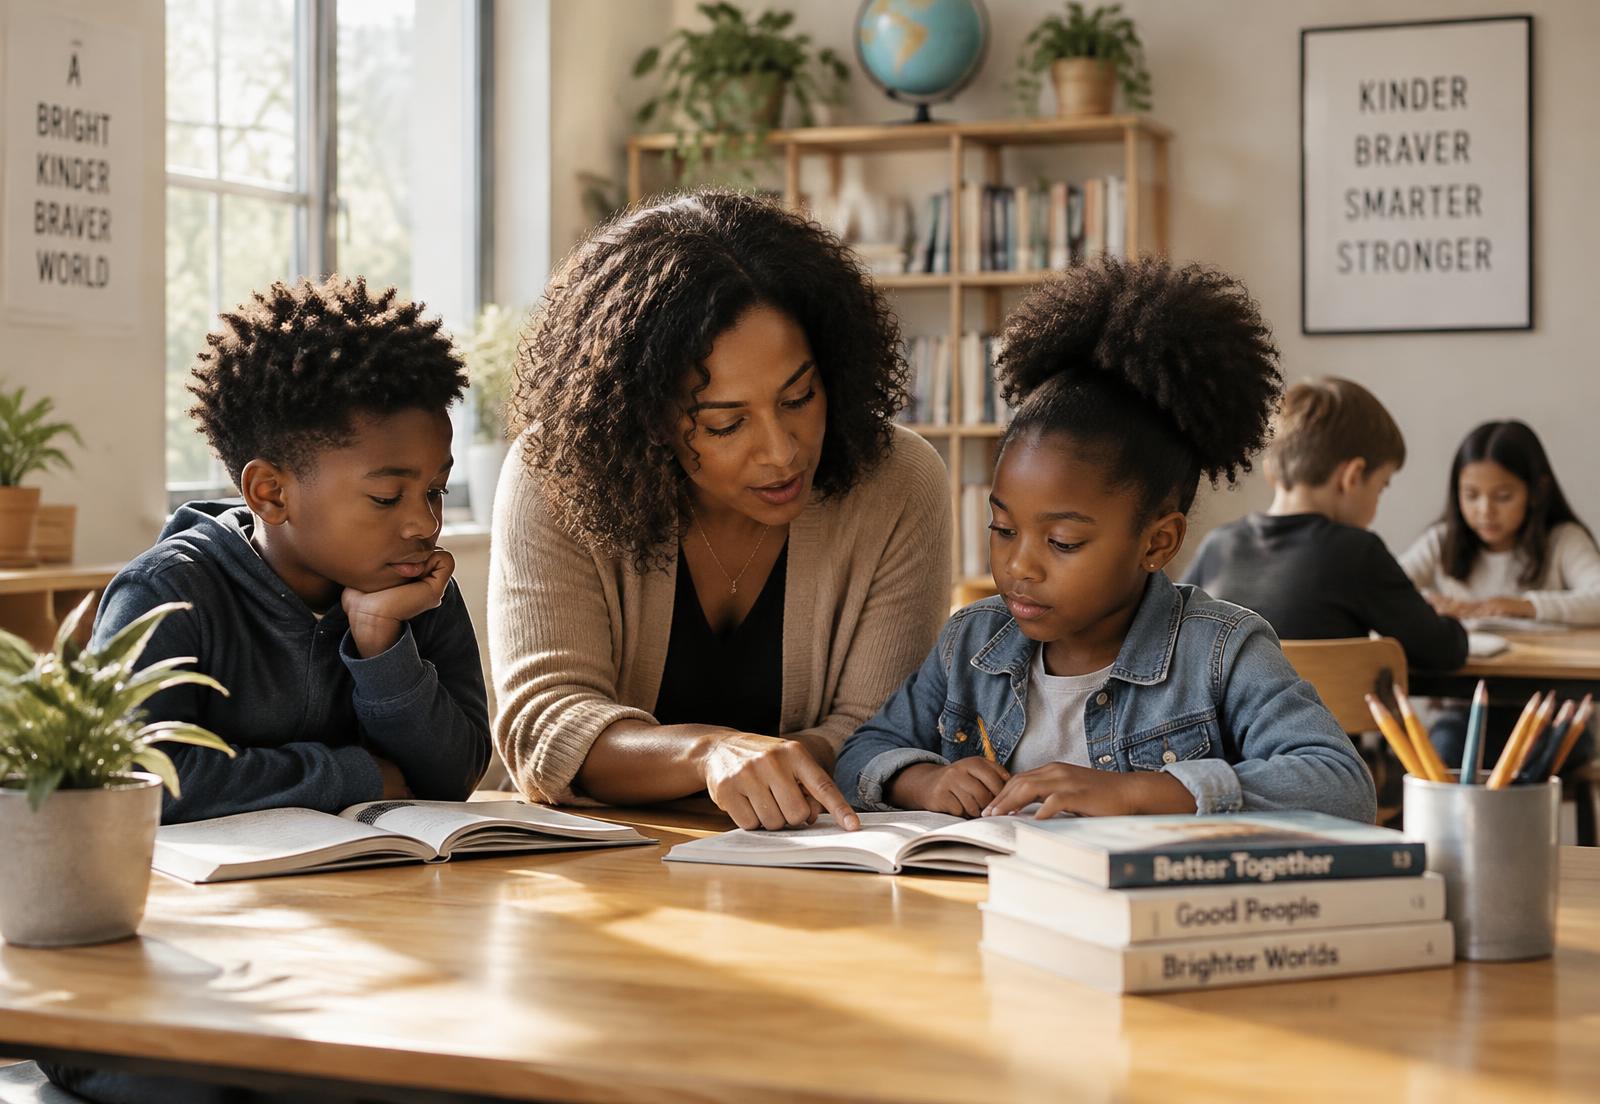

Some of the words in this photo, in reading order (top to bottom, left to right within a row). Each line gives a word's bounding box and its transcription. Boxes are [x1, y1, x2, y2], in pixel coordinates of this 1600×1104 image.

[1359, 77, 1468, 112] KINDER
[37, 103, 111, 146] BRIGHT
[1355, 131, 1471, 166] BRAVER
[36, 153, 109, 194] KINDER
[1346, 185, 1483, 220] SMARTER
[35, 202, 111, 242] BRAVER
[36, 251, 109, 288] WORLD
[1337, 238, 1492, 274] STRONGER
[1153, 856, 1229, 881] Better
[1231, 853, 1333, 880] Together
[1177, 902, 1238, 926] Good
[1246, 897, 1320, 924] People
[1164, 953, 1256, 983] Brighter
[1265, 943, 1340, 967] Worlds
